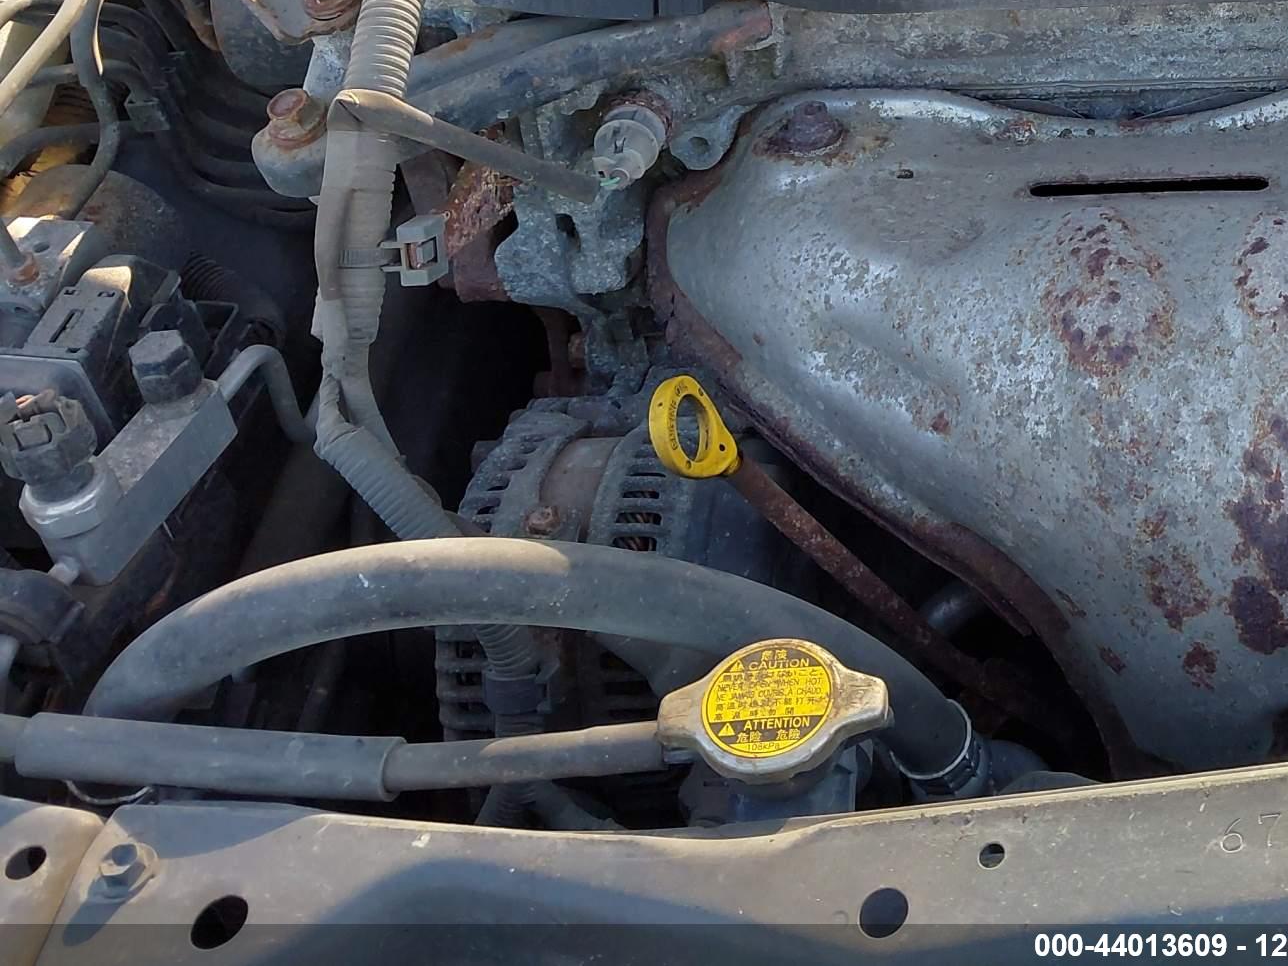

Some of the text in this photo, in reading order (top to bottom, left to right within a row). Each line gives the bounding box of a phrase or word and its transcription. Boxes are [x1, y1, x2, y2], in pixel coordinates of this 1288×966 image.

[748, 657, 810, 671] CAUTION
[805, 677, 823, 686] HOT
[743, 716, 810, 731] ATTENTION
